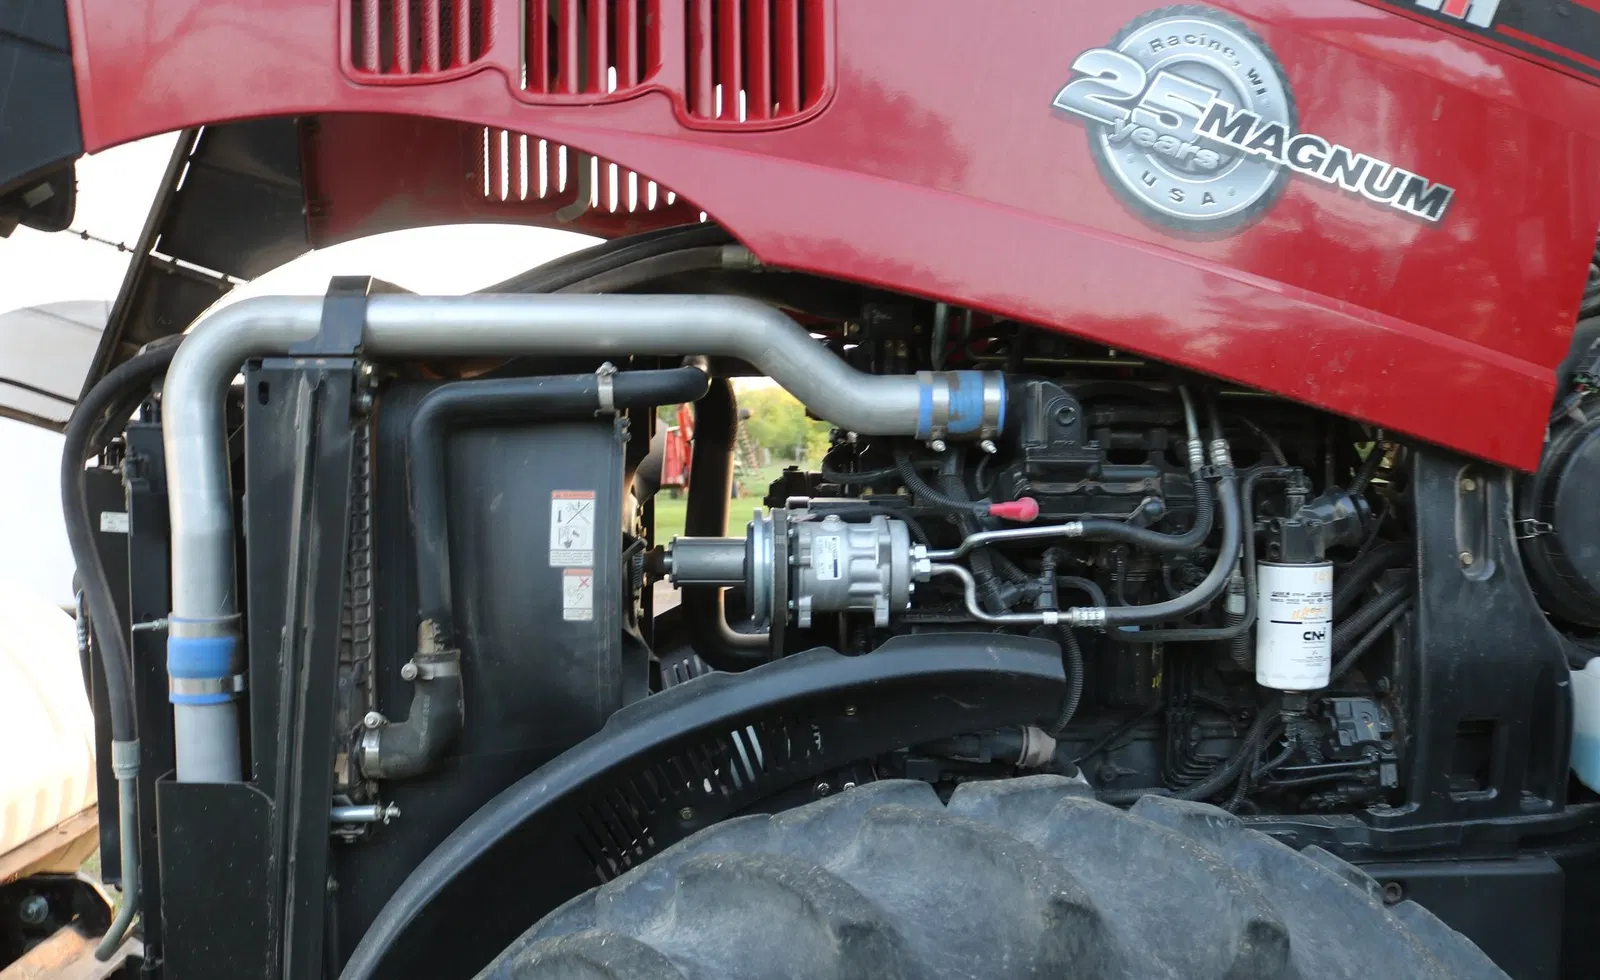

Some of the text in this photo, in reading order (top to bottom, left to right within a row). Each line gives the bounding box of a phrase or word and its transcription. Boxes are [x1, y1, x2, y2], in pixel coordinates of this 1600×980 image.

[1149, 33, 1267, 95] Racine, WI
[1053, 48, 1221, 145] 25
[1107, 118, 1221, 170] years
[1194, 99, 1456, 222] MAGNUM
[1303, 630, 1326, 641] CNH
